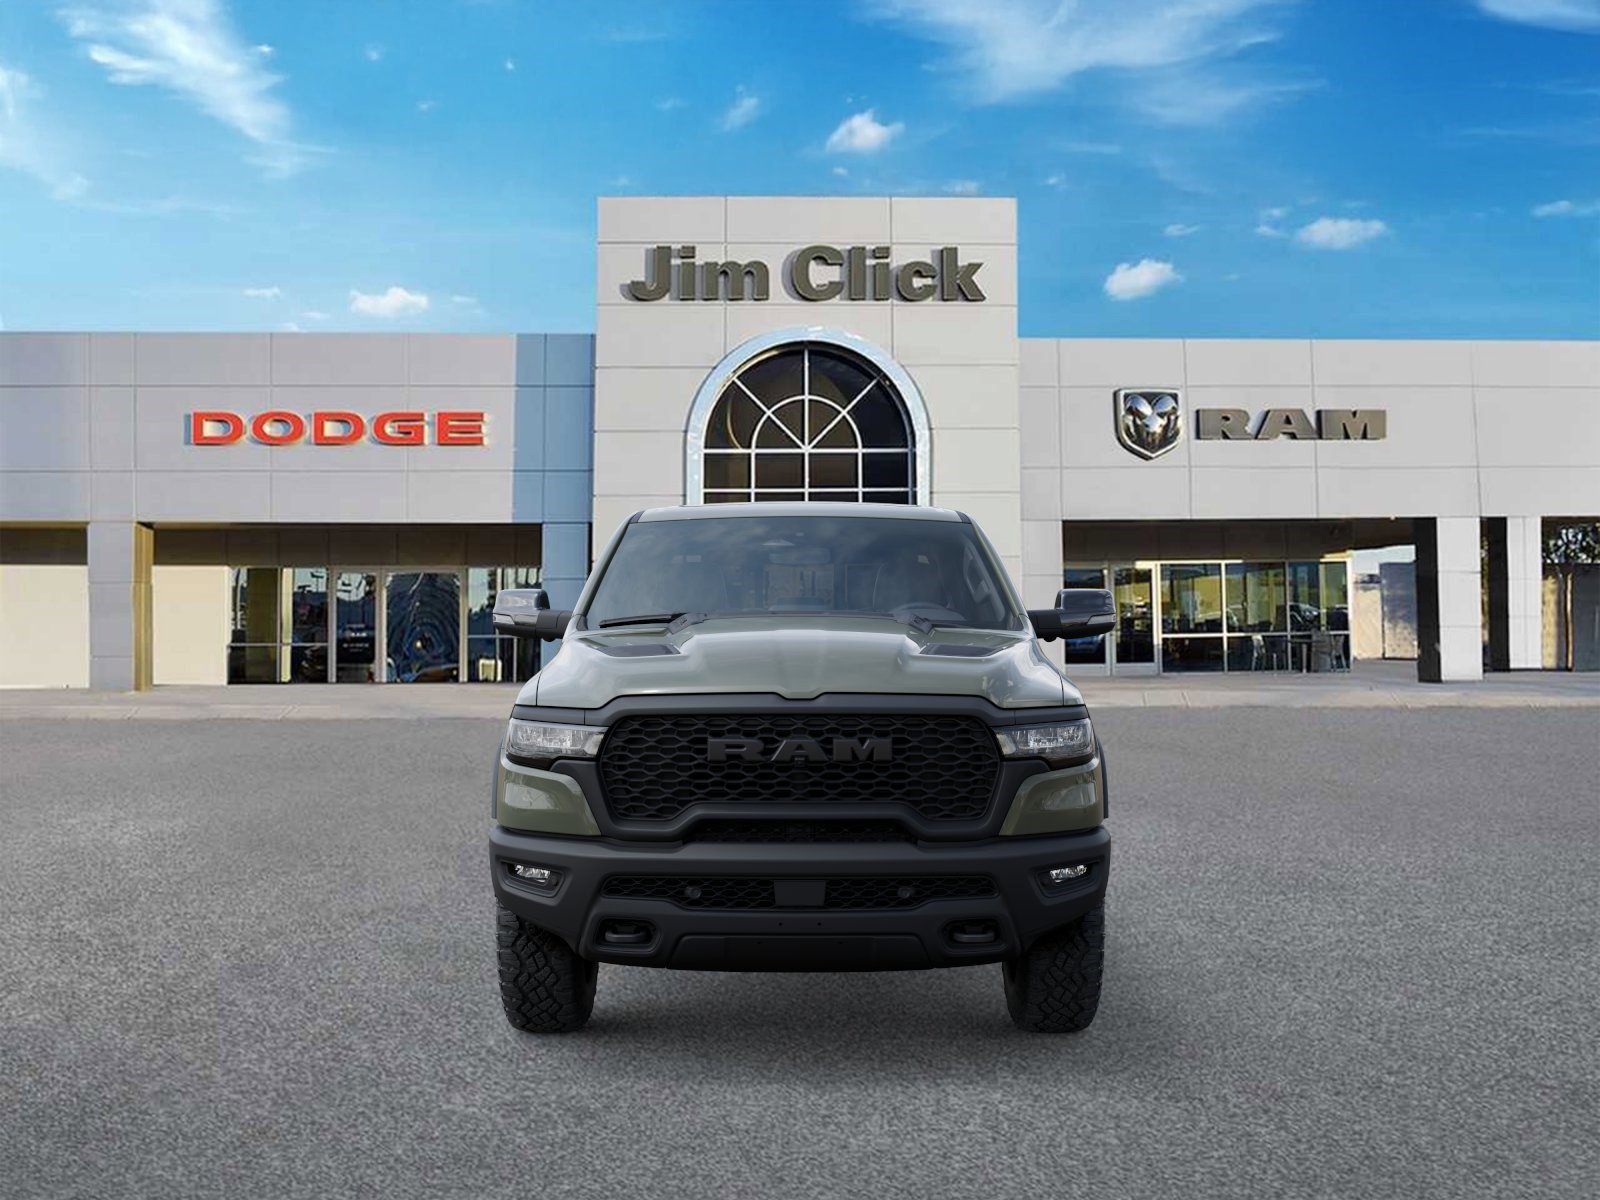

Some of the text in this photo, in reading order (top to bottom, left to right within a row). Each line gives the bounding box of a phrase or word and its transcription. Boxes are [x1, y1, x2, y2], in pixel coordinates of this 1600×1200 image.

[627, 244, 987, 302] Jim Click
[192, 410, 486, 446] DODGE
[1195, 408, 1387, 440] RAM
[707, 736, 893, 763] RAM
